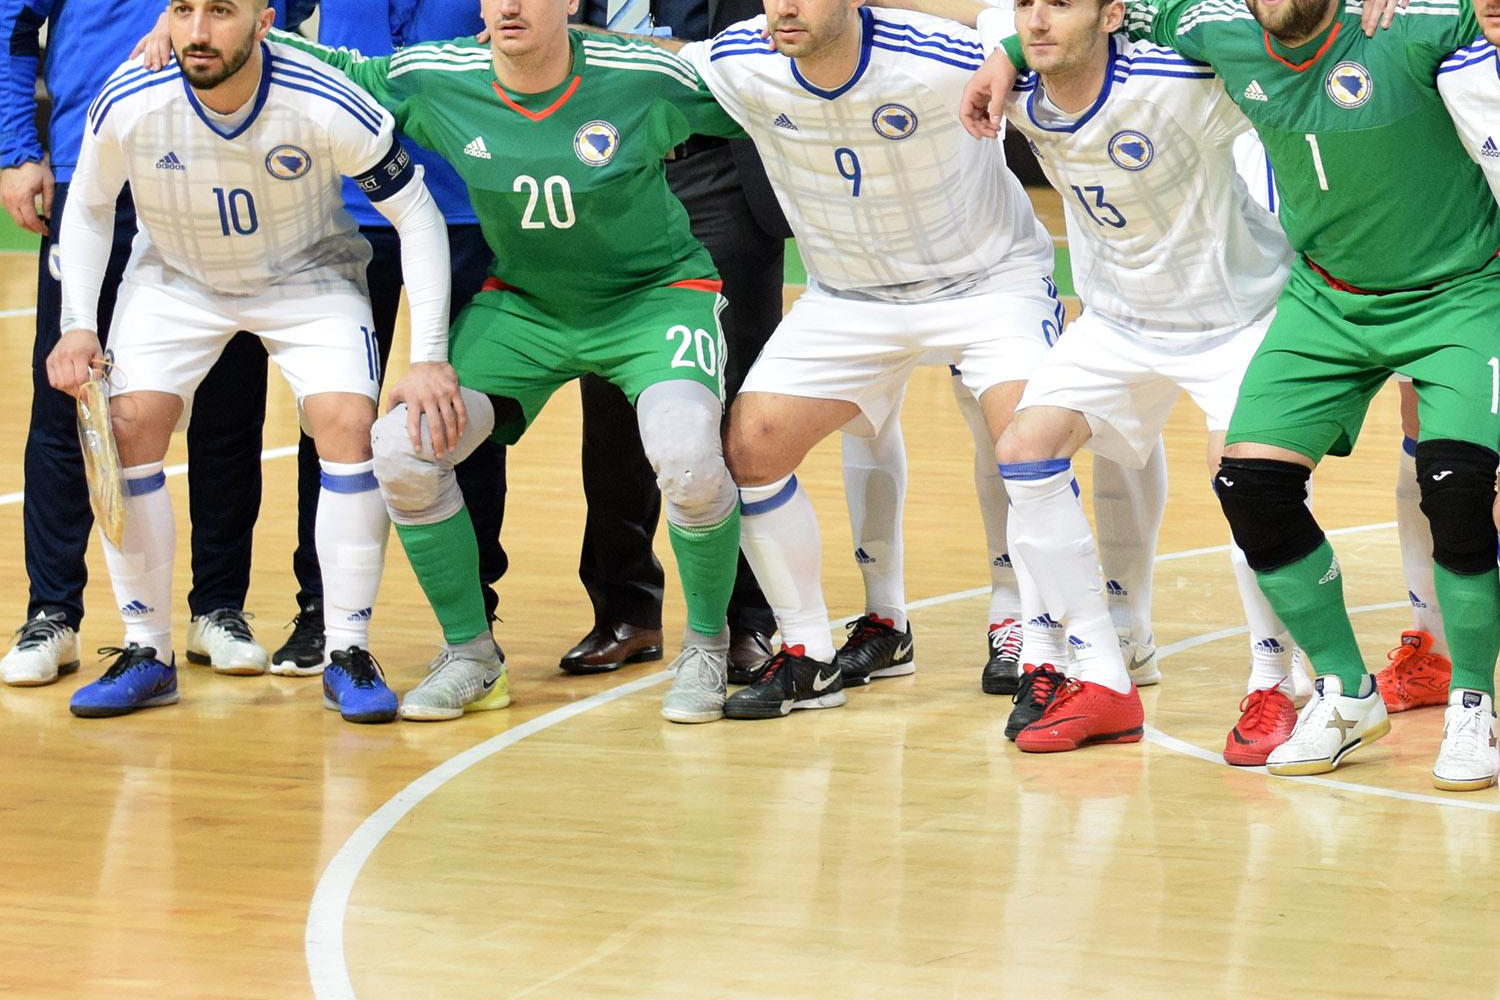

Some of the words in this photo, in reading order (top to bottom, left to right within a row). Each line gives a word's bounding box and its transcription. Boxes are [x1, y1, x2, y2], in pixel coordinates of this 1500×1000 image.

[463, 147, 492, 160] adidas
[834, 147, 861, 197] 9
[1305, 133, 1329, 191] 1
[212, 187, 259, 237] 10
[512, 174, 576, 230] 20
[1071, 184, 1127, 228] 13
[665, 324, 716, 377] 20
[1487, 356, 1500, 415] 1
